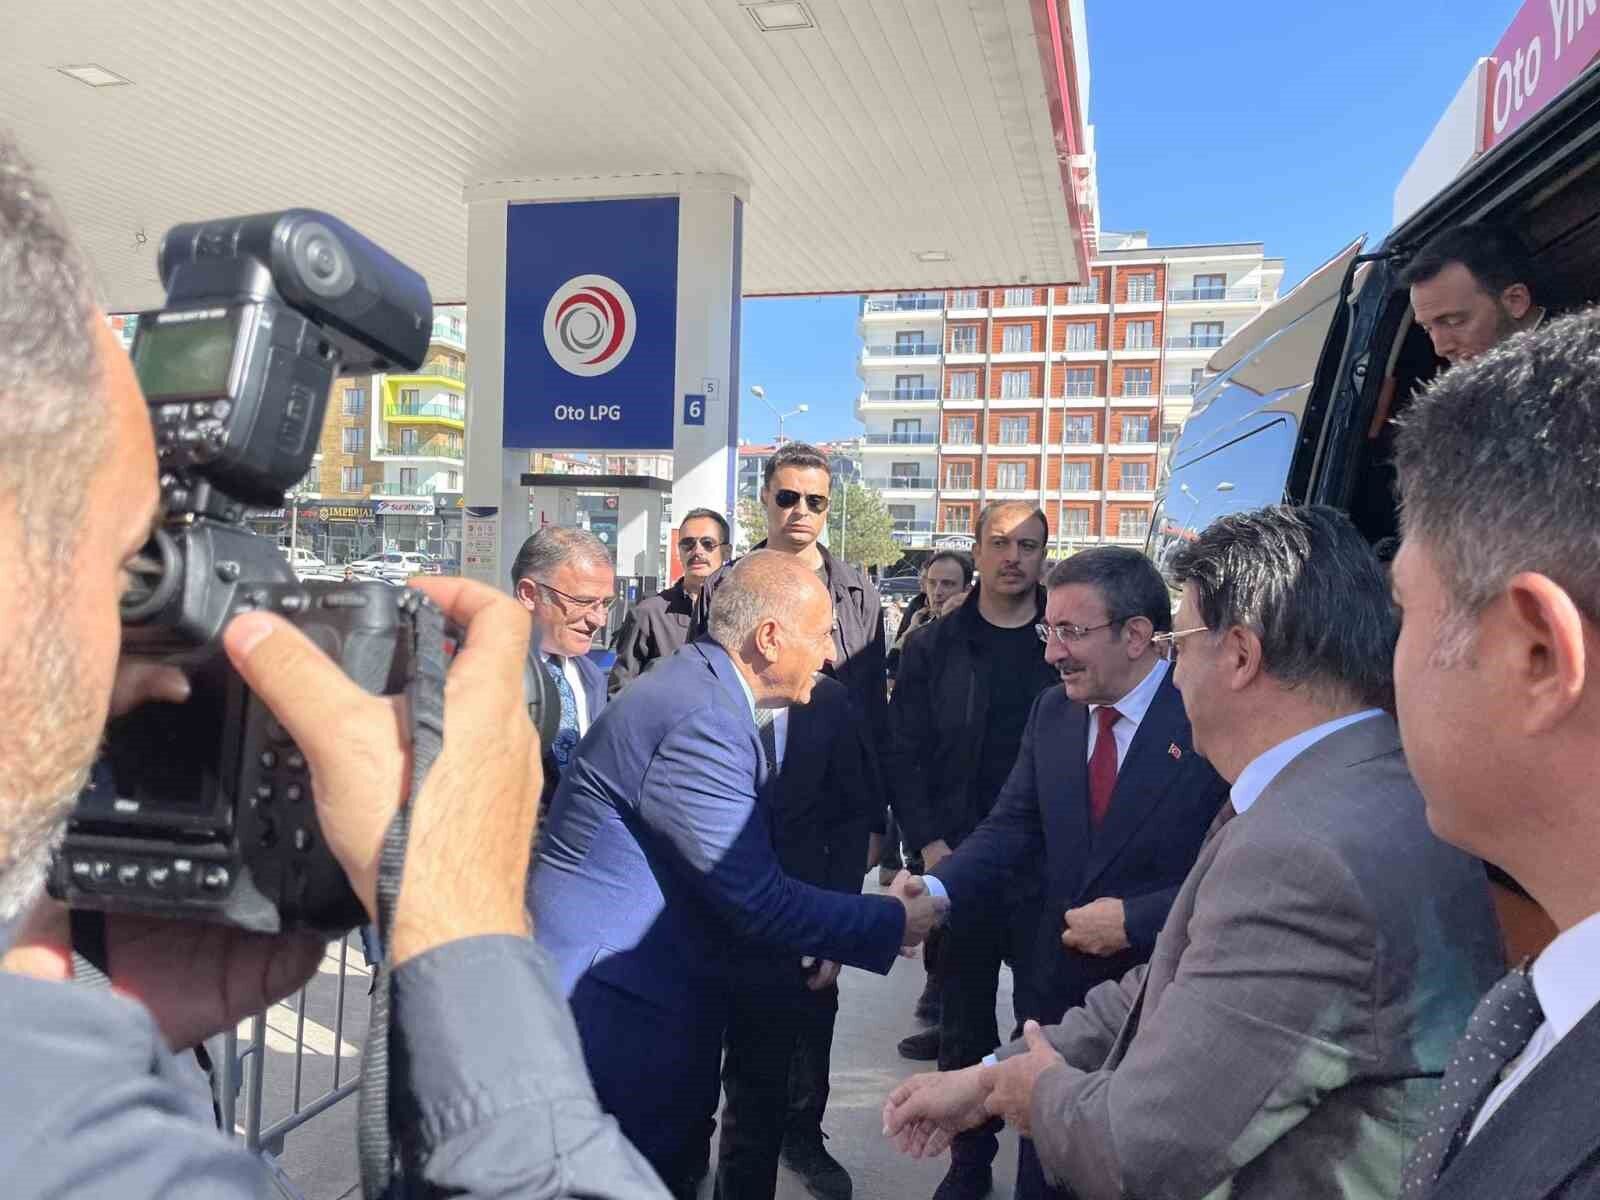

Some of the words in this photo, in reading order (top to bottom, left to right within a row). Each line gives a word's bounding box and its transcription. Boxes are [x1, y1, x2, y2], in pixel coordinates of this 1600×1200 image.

[1493, 36, 1541, 134] Oto
[706, 383, 715, 394] 5
[554, 405, 585, 421] Oto
[590, 405, 622, 421] LPG
[689, 401, 702, 418] 6
[329, 507, 374, 517] IMPERIAL
